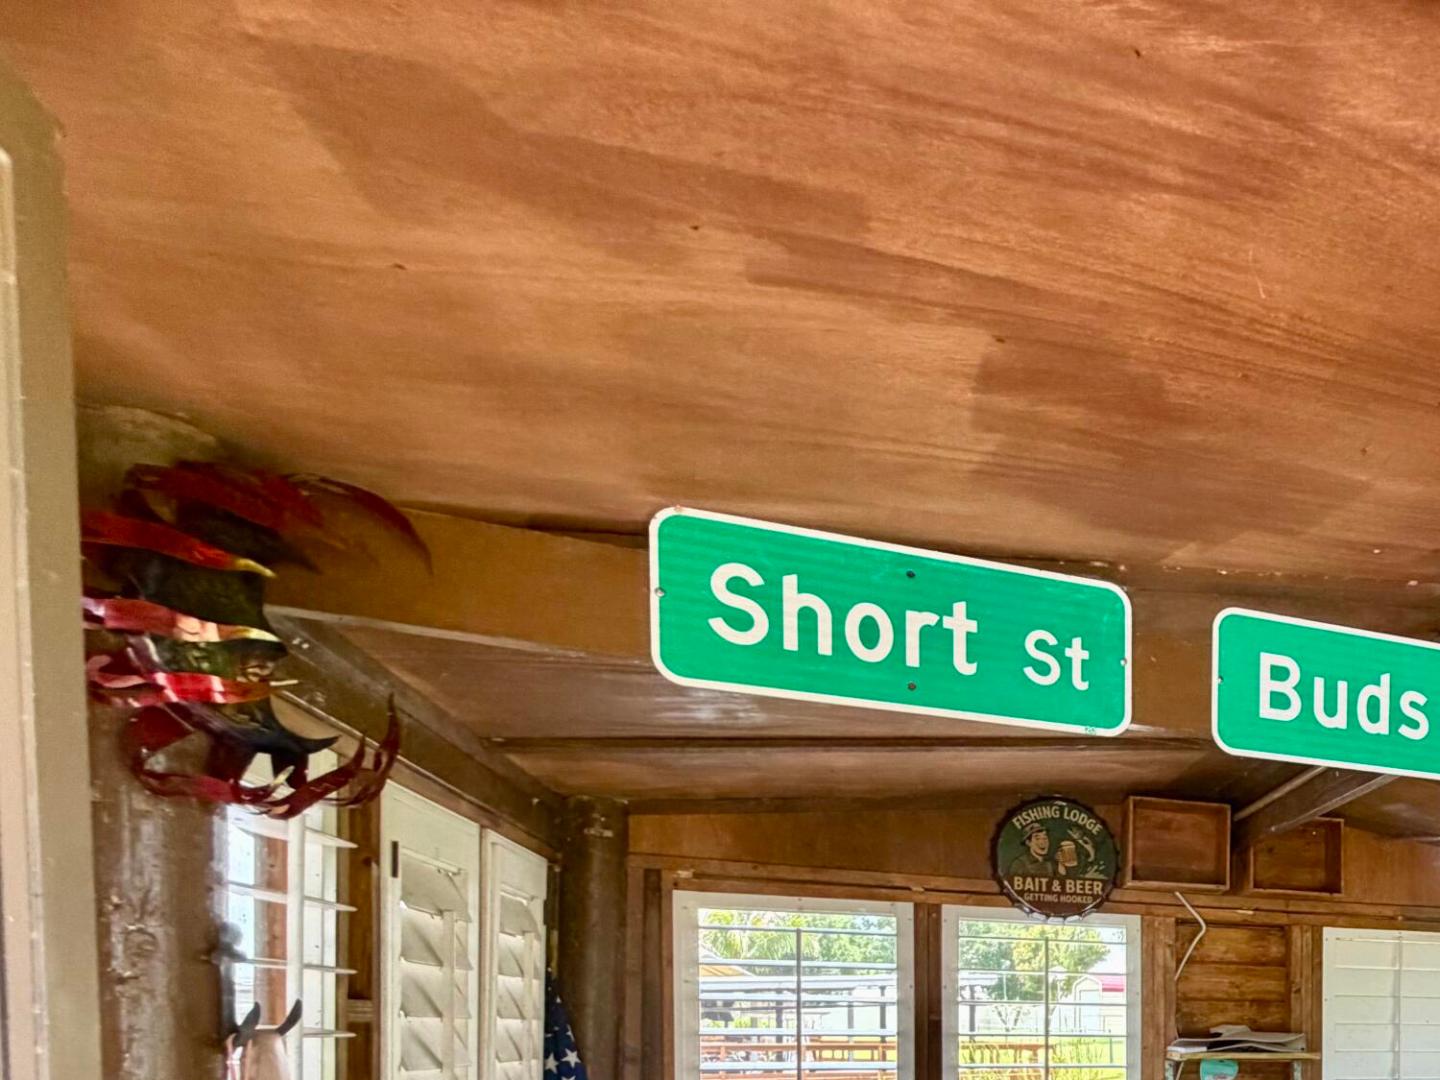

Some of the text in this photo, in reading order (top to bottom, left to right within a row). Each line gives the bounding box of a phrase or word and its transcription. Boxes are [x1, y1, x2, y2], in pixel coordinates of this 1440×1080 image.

[708, 562, 1090, 691] Short St
[1258, 651, 1430, 740] Buds
[1012, 805, 1104, 836] FISHING LODGE
[1013, 876, 1103, 895] BAIT & BEER
[1023, 892, 1059, 903] GETTING
